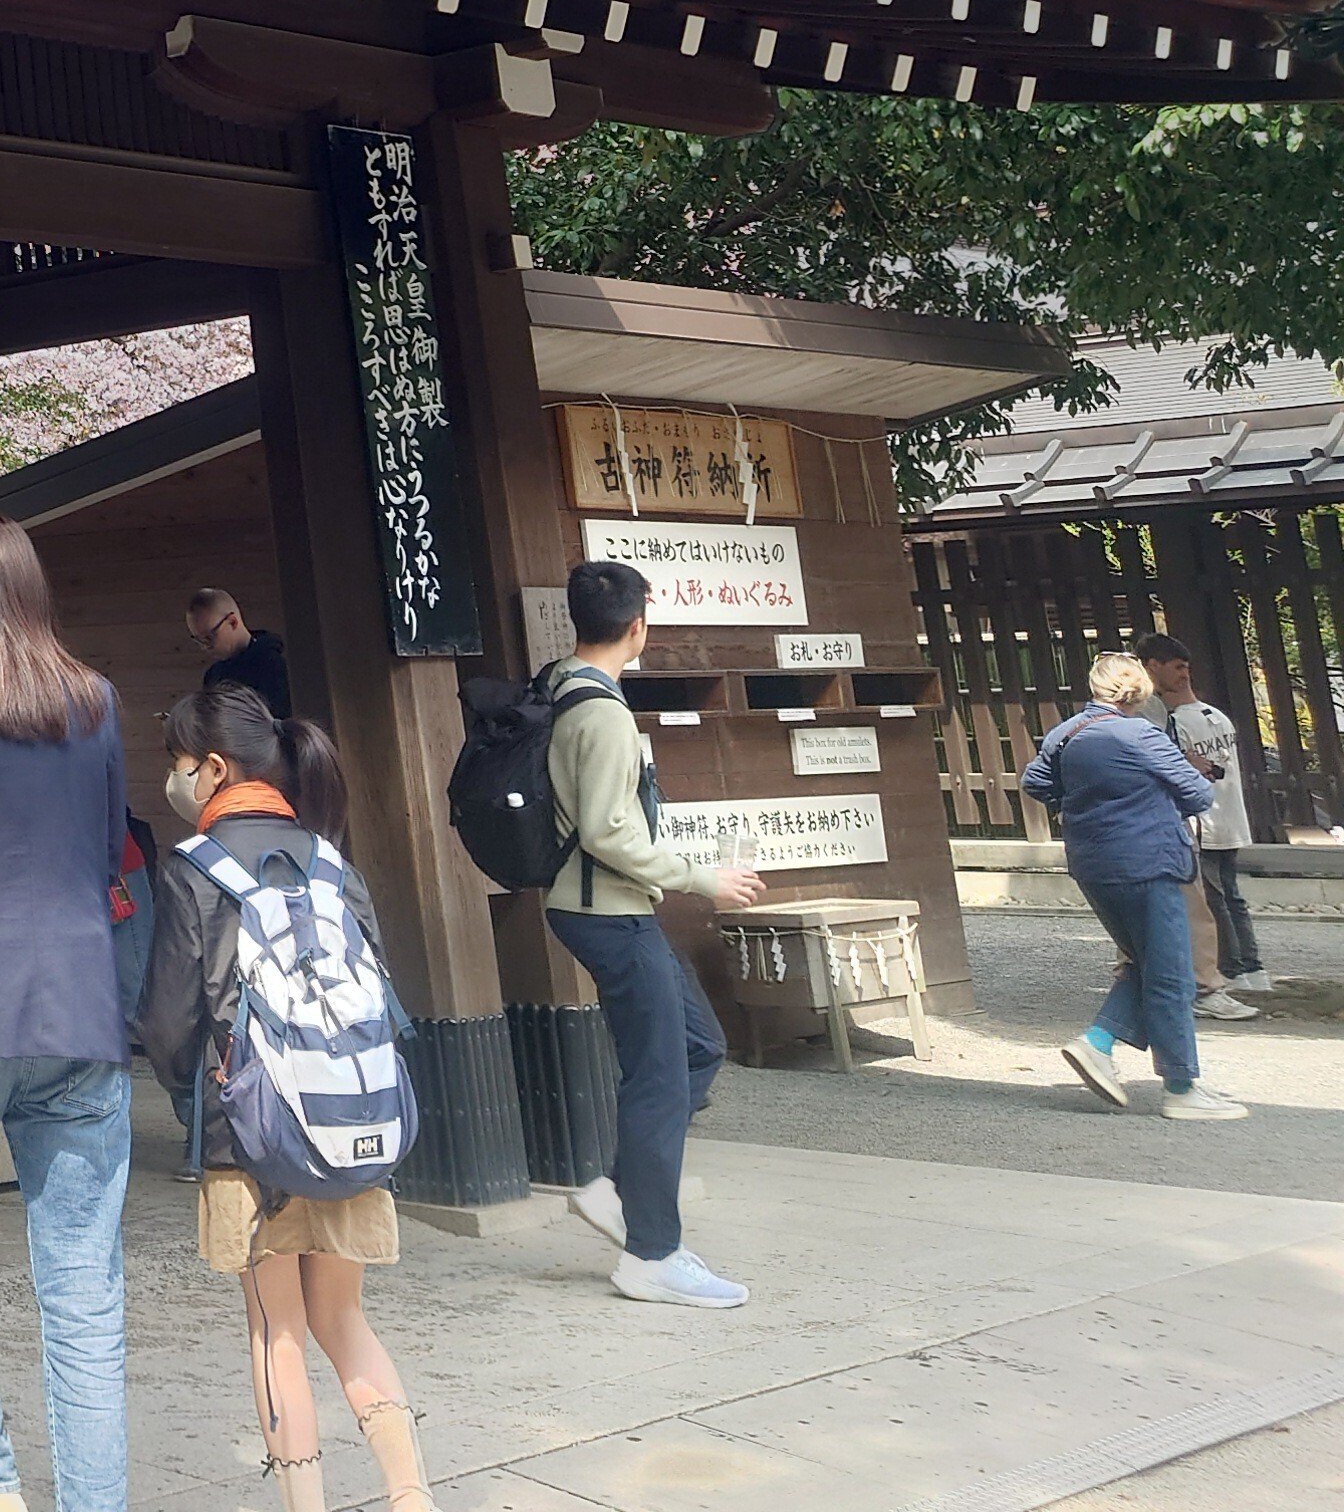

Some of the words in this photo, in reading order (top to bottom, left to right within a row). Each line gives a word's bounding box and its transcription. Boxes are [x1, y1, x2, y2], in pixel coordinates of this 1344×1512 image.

[385, 141, 450, 429] 明治天皇御製
[605, 536, 785, 565] ここに納めてはいけないもの
[790, 640, 852, 661] お札・お守り
[801, 738, 814, 748] This
[816, 737, 826, 748] box
[837, 737, 846, 747] old
[806, 755, 819, 765] This
[826, 755, 838, 765] not
[357, 1137, 378, 1154] HH
